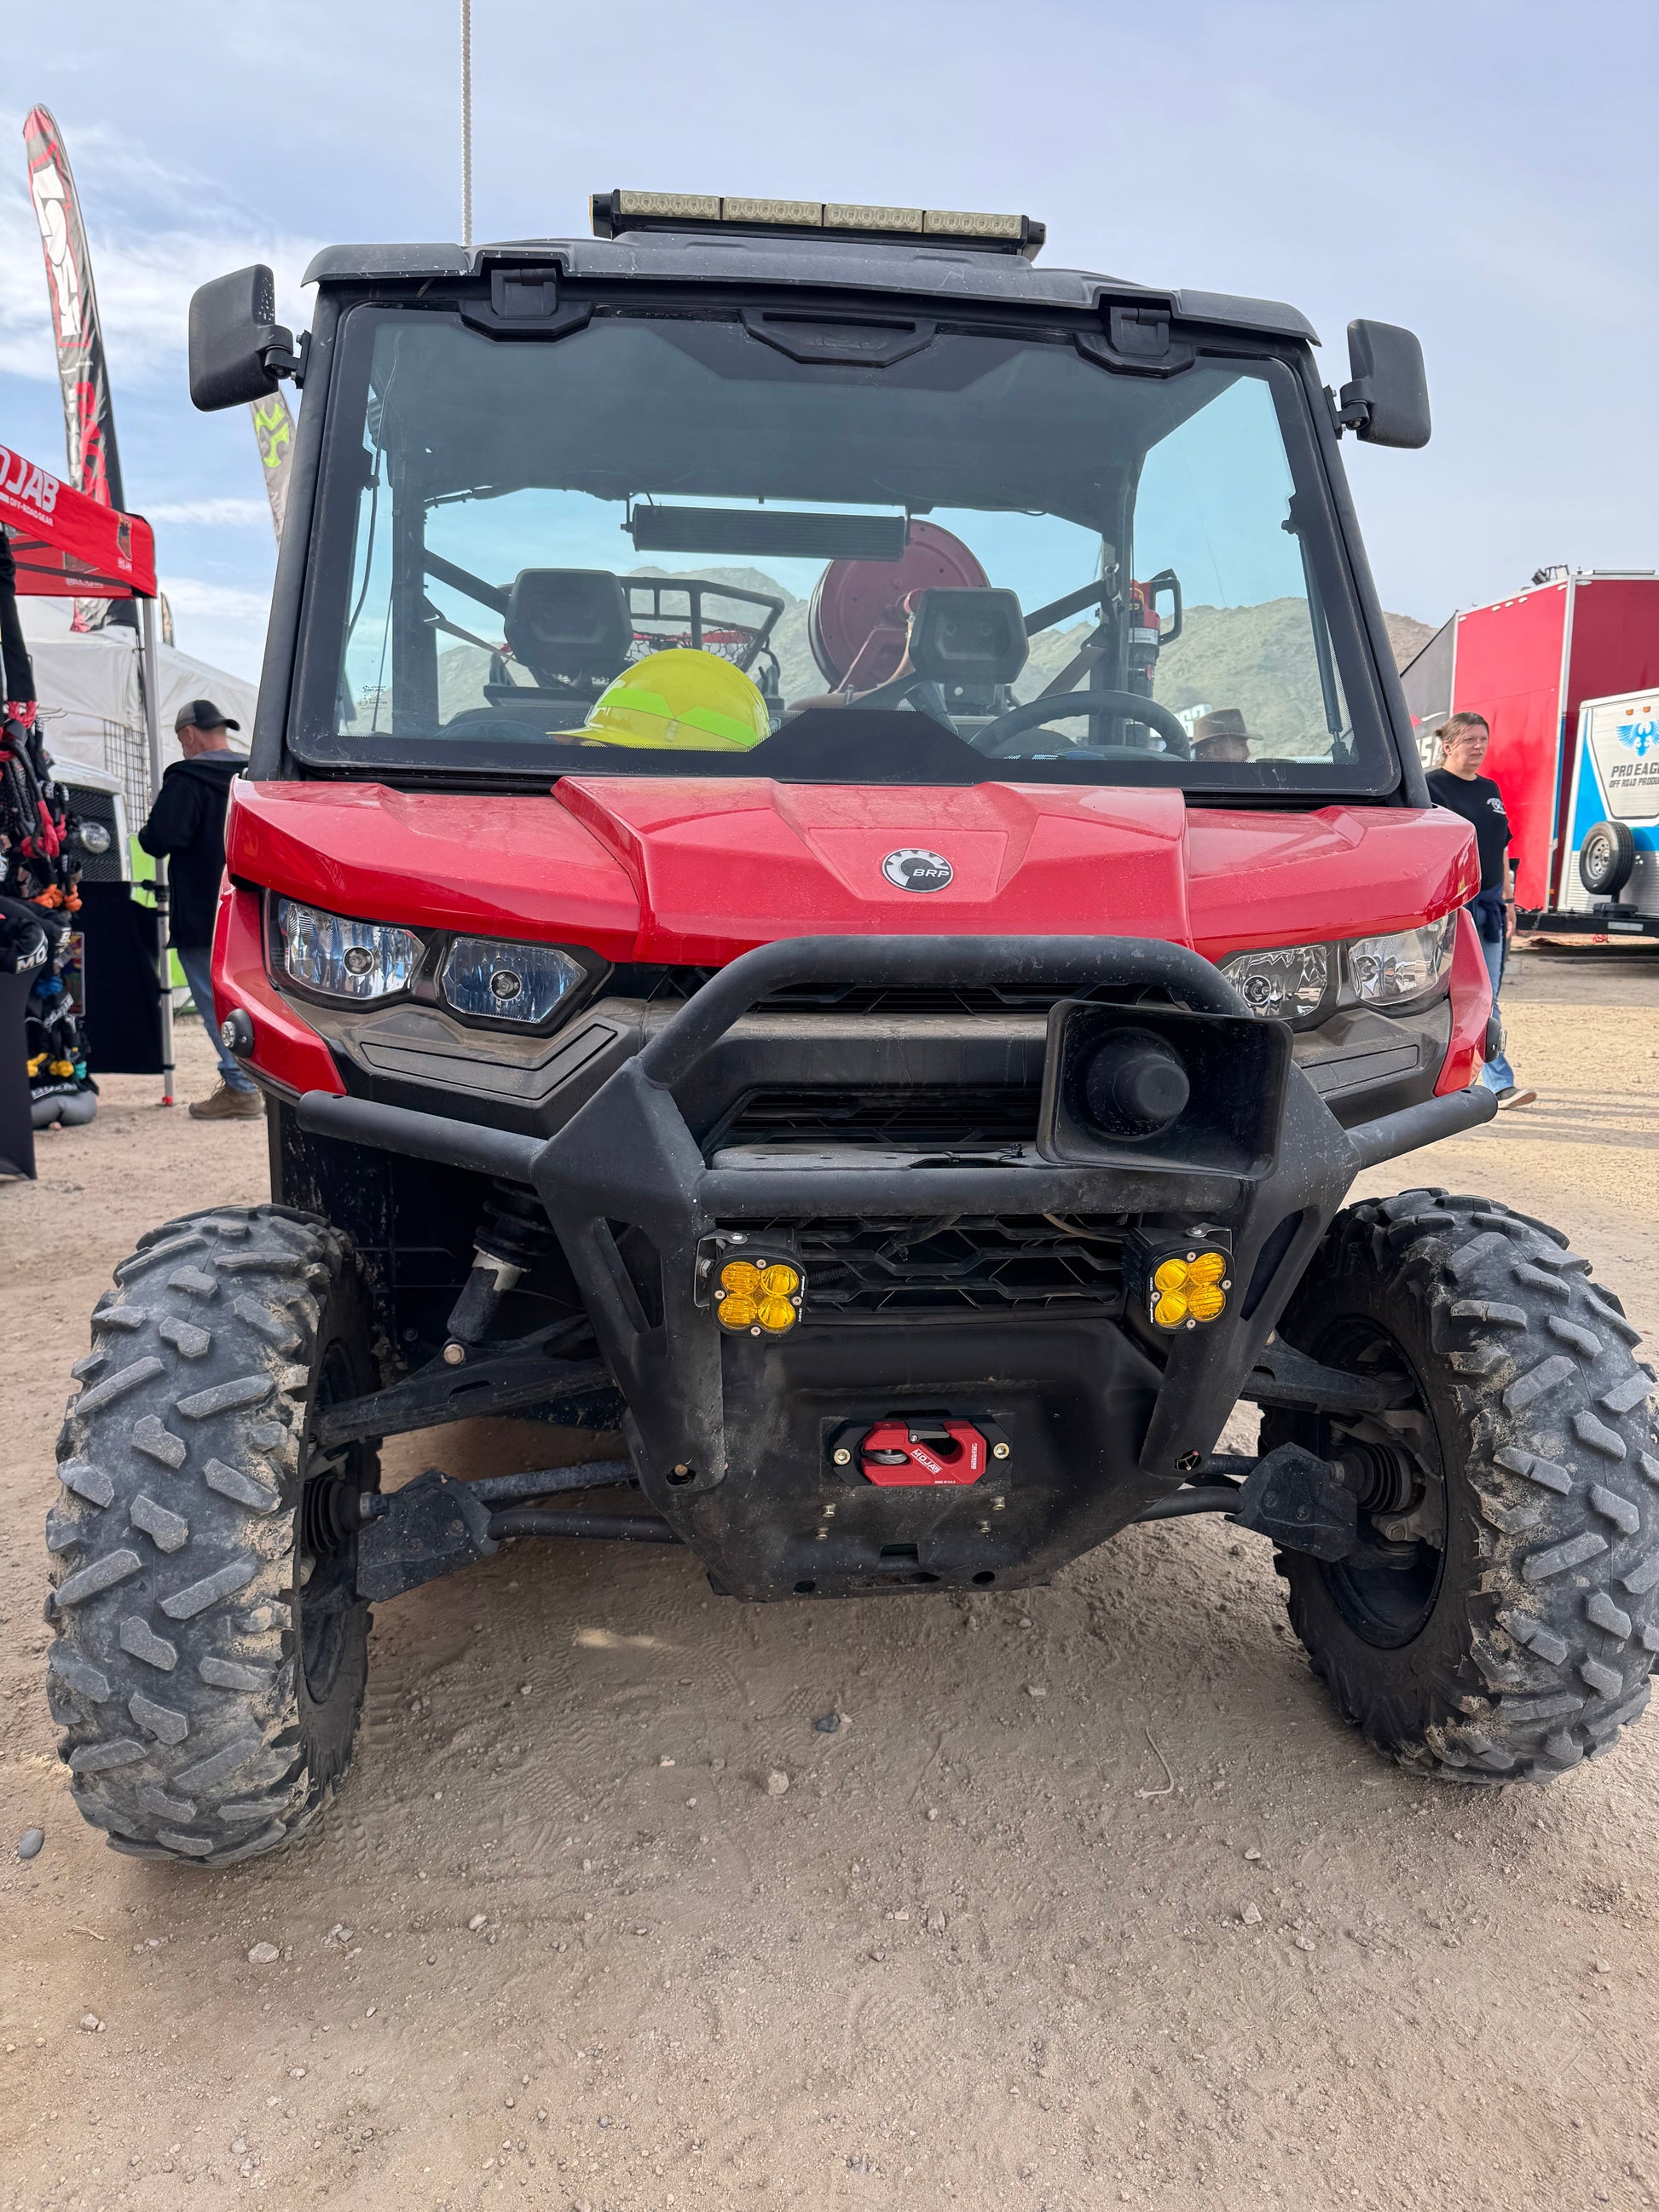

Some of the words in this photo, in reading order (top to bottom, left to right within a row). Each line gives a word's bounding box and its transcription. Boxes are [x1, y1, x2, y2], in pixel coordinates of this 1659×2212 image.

[1610, 764, 1633, 777] PRO
[1634, 762, 1659, 777] EAG
[912, 869, 950, 878] BRP
